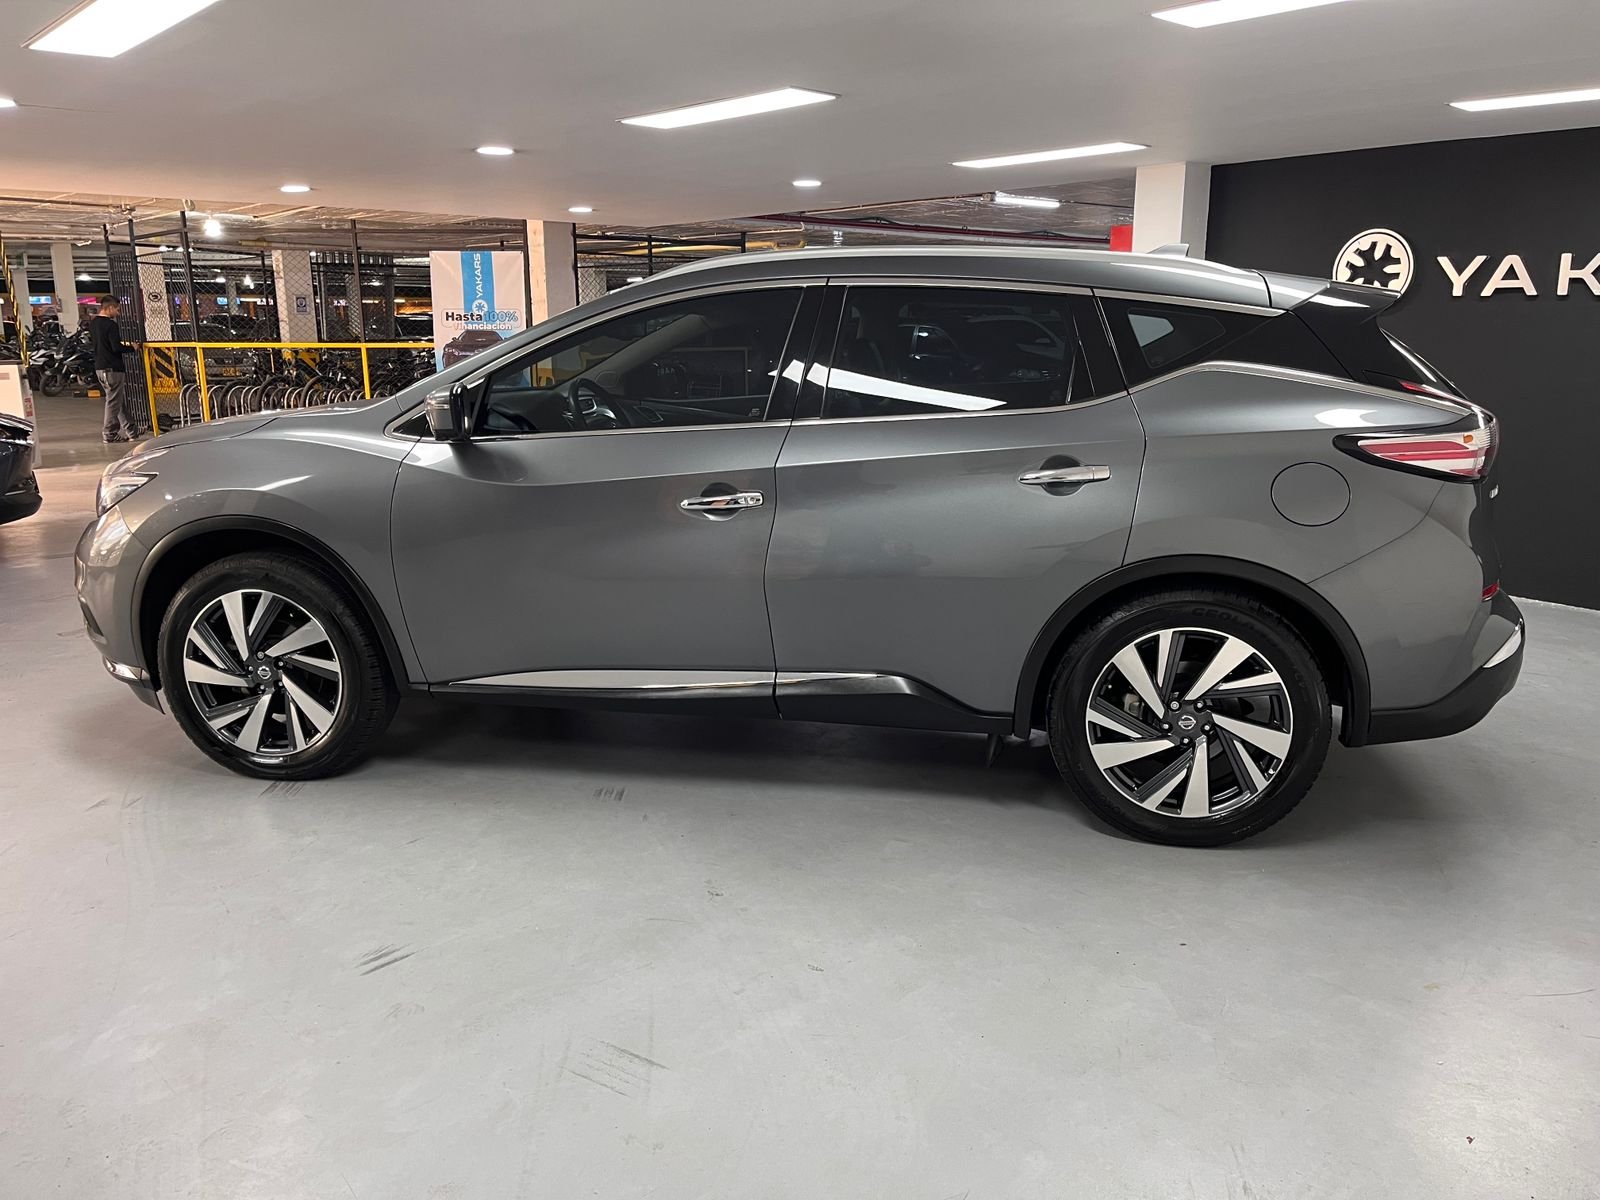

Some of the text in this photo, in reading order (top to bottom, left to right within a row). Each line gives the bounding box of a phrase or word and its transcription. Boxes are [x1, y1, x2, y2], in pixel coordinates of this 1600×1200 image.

[473, 253, 484, 299] YAKARS
[1436, 252, 1600, 298] YAK
[445, 310, 519, 323] Hasta 100%
